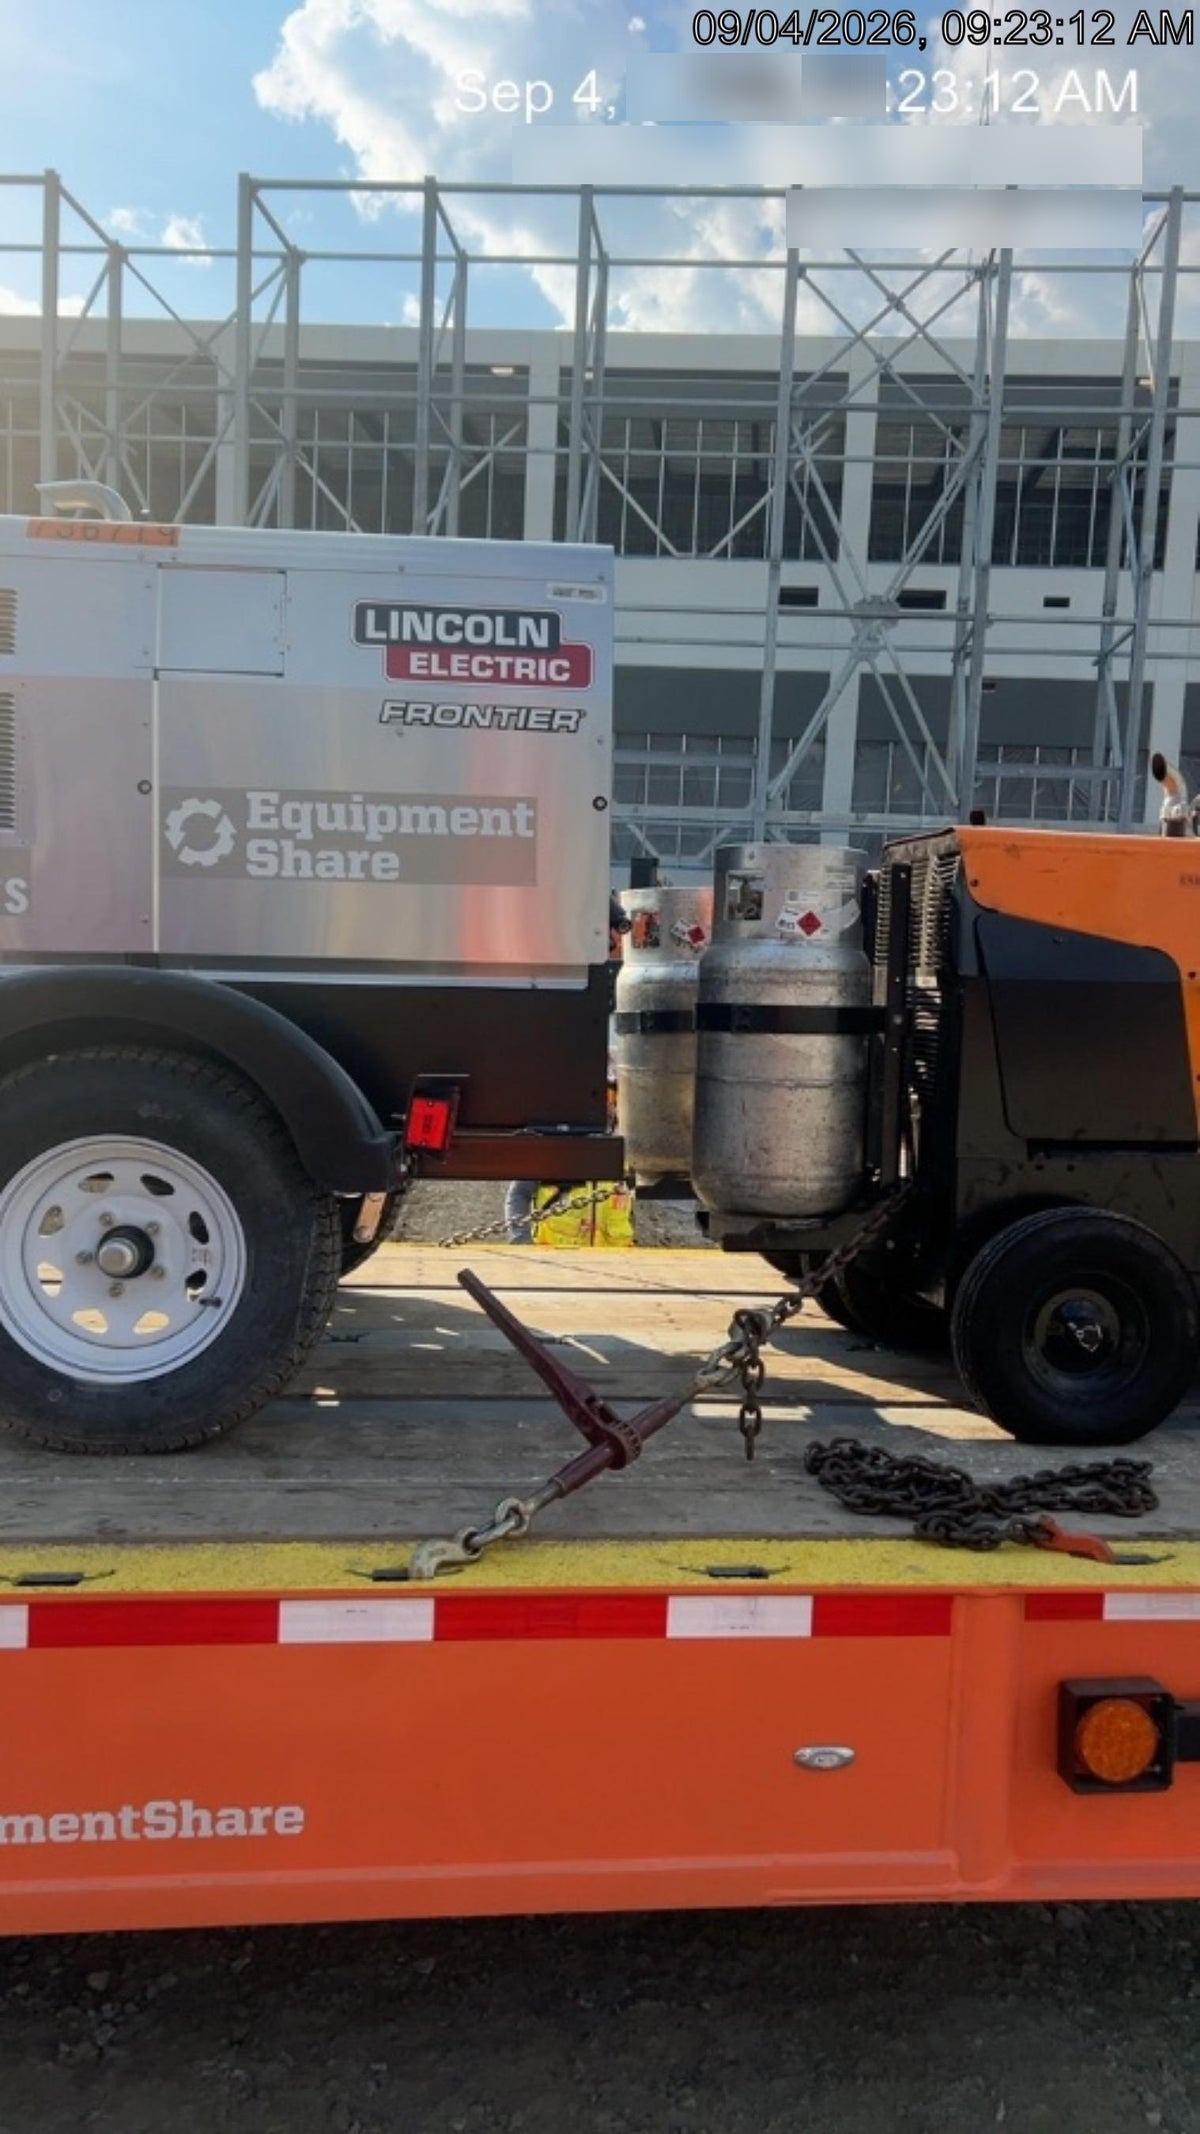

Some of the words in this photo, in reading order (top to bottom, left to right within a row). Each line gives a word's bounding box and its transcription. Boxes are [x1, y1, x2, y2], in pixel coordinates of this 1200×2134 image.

[365, 609, 549, 648] LINCOLN
[410, 652, 570, 681] ELECTRIC
[379, 700, 583, 733] FRONTIER
[246, 791, 534, 842] Equipment
[246, 839, 400, 880] Share
